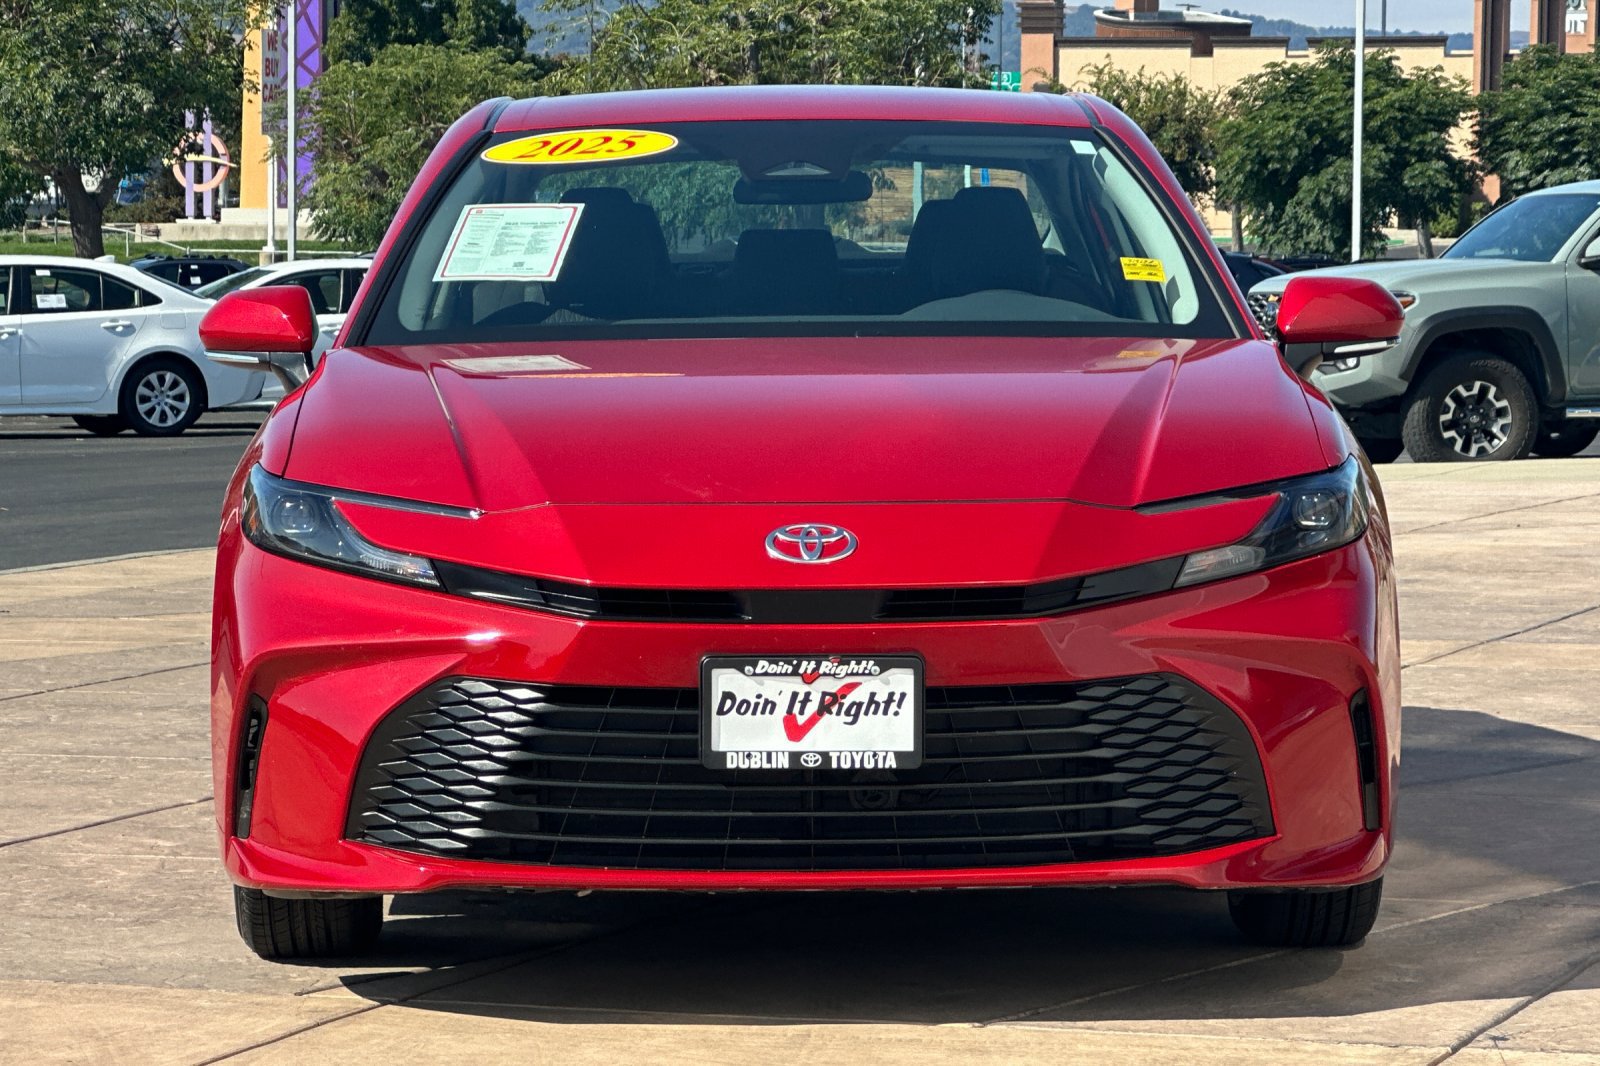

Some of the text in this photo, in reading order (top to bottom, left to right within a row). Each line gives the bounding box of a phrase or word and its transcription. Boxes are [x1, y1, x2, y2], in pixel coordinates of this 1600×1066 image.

[267, 32, 278, 51] WE
[265, 58, 279, 78] BUY
[514, 134, 647, 159] 2025
[755, 660, 875, 678] Doin' It Right!
[716, 690, 908, 726] Doin' It Right!
[726, 751, 897, 769] DUBLIN TOYOTA
